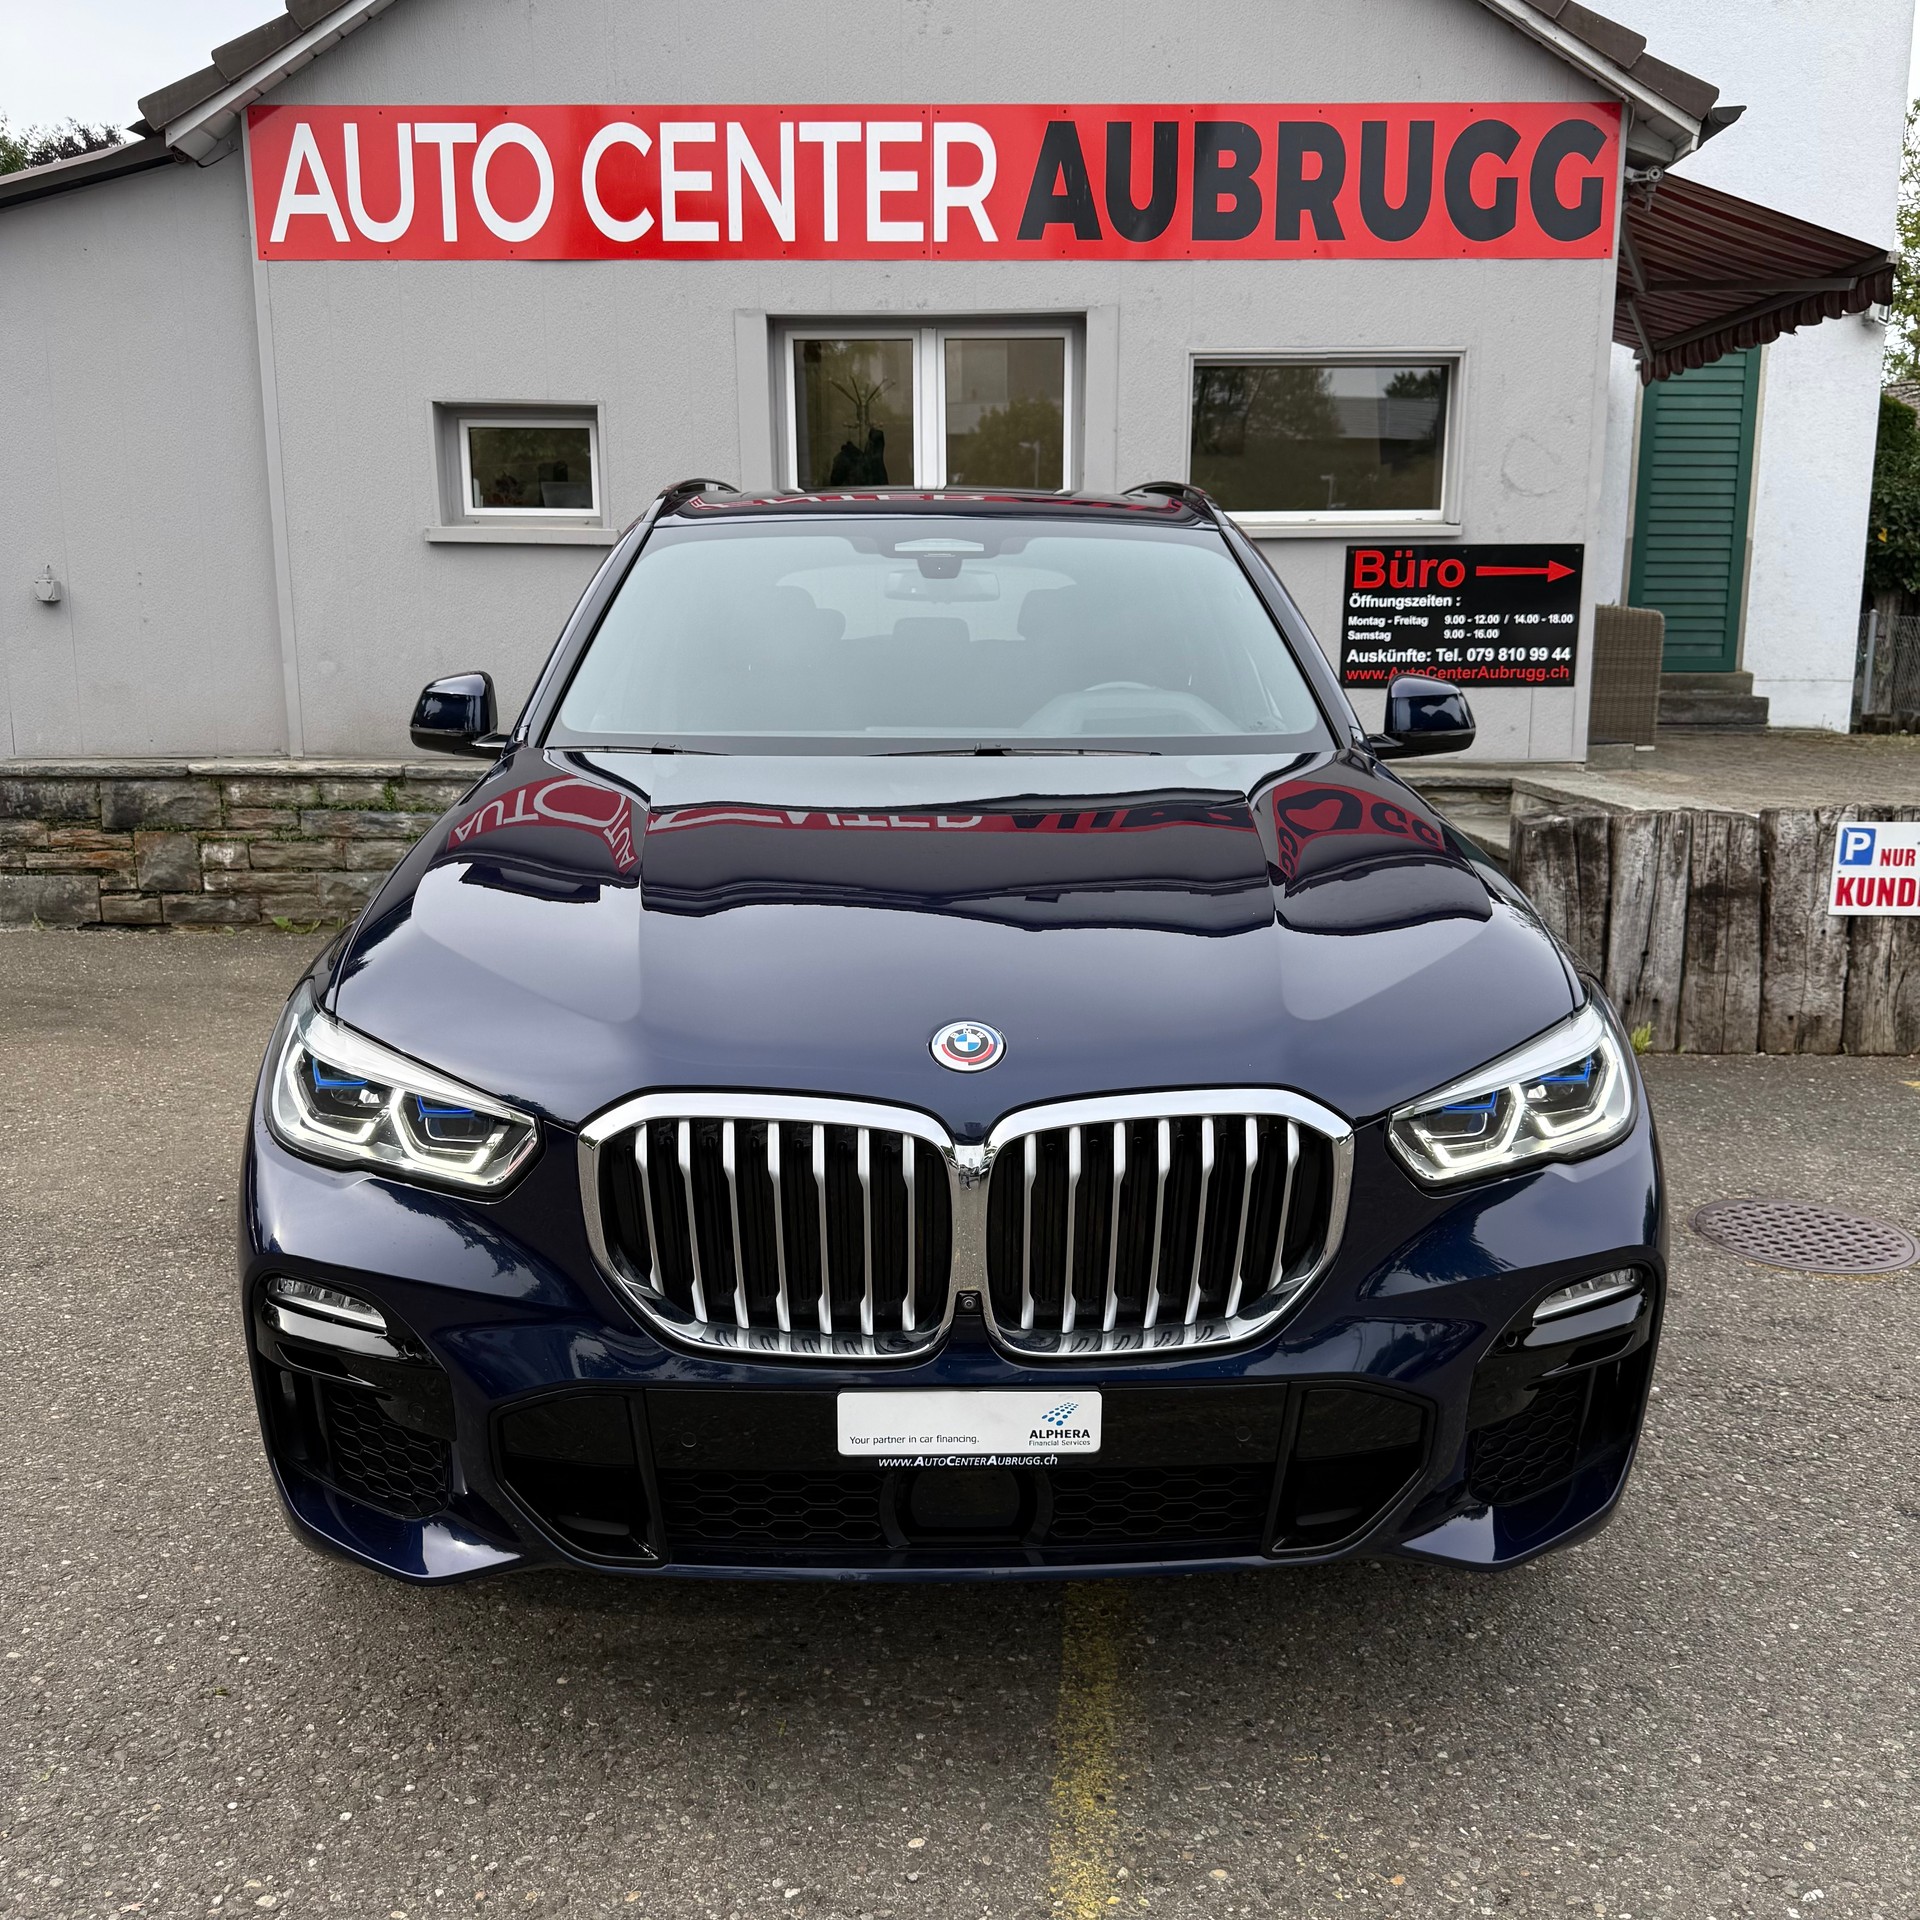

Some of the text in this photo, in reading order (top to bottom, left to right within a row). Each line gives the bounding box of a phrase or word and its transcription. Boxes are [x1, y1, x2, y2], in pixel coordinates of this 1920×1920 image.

[270, 119, 1608, 243] AUTO CENTER AUBRUGG
[1353, 550, 1466, 589] Büro
[1349, 592, 1452, 610] Öffnungszeiten
[1348, 616, 1386, 628] Montag
[1394, 615, 1429, 627] Freitag
[1444, 614, 1466, 625] 9.00
[1474, 614, 1500, 625] 12.00
[1513, 613, 1540, 624] 14.00
[1548, 613, 1574, 624] 18.00
[1347, 630, 1392, 642] Samstag
[1443, 629, 1465, 639] 9.00
[1473, 628, 1500, 639] 16.00
[1346, 646, 1571, 663] Auskünfte: Tel. 079 810 99 44
[1346, 665, 1569, 682] www.AtoCenterAubrugg.ch
[1880, 848, 1916, 866] NUR
[1835, 877, 1920, 907] KUND
[949, 1028, 985, 1039] BMW
[849, 1436, 870, 1445] Your
[873, 1435, 906, 1445] partner
[908, 1435, 917, 1443] in
[936, 1434, 980, 1444] financing.
[1029, 1429, 1090, 1439] ALPHERA
